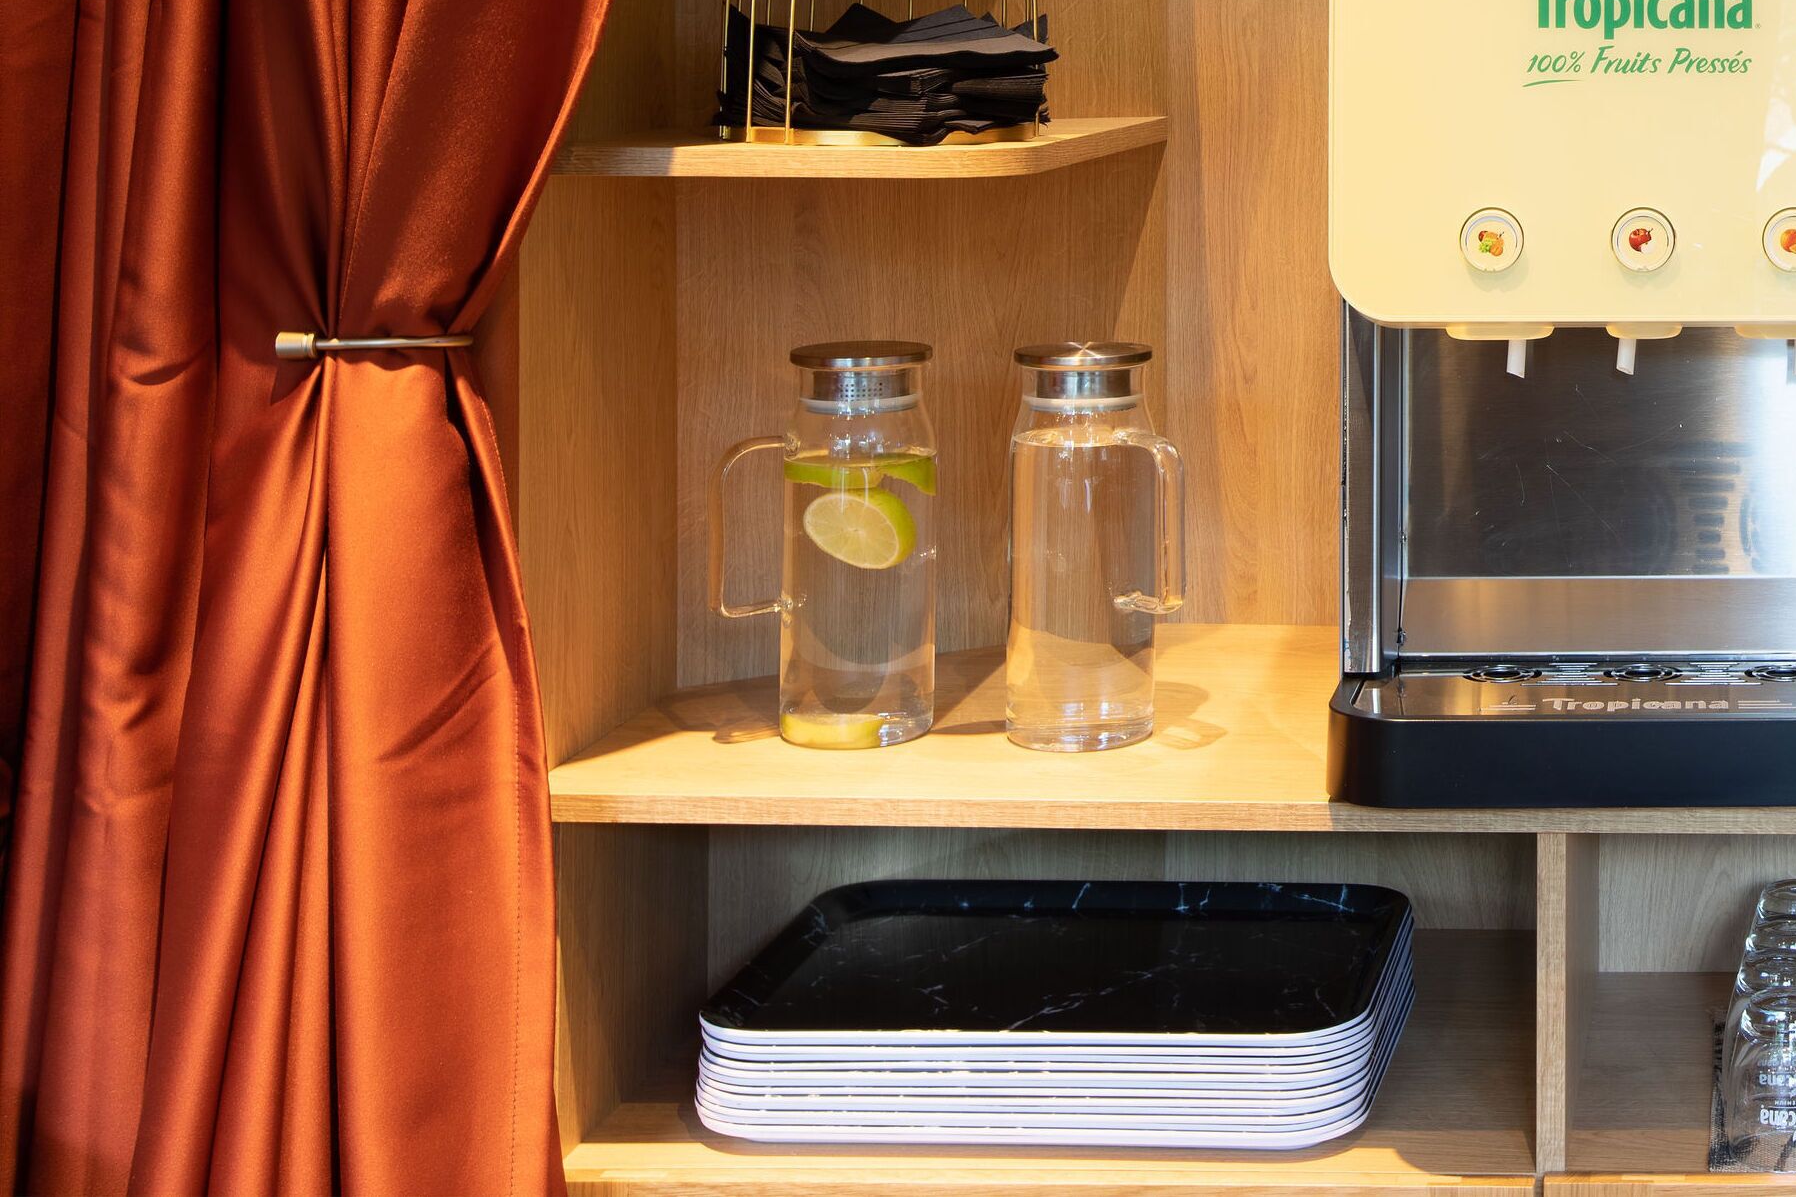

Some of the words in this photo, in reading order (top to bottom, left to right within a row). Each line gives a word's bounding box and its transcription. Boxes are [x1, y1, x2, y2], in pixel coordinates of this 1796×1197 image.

[1526, 51, 1586, 73] 100%
[1590, 45, 1662, 74] Fruits
[1667, 47, 1753, 74] Pressés
[1542, 697, 1729, 712] Tropicana
